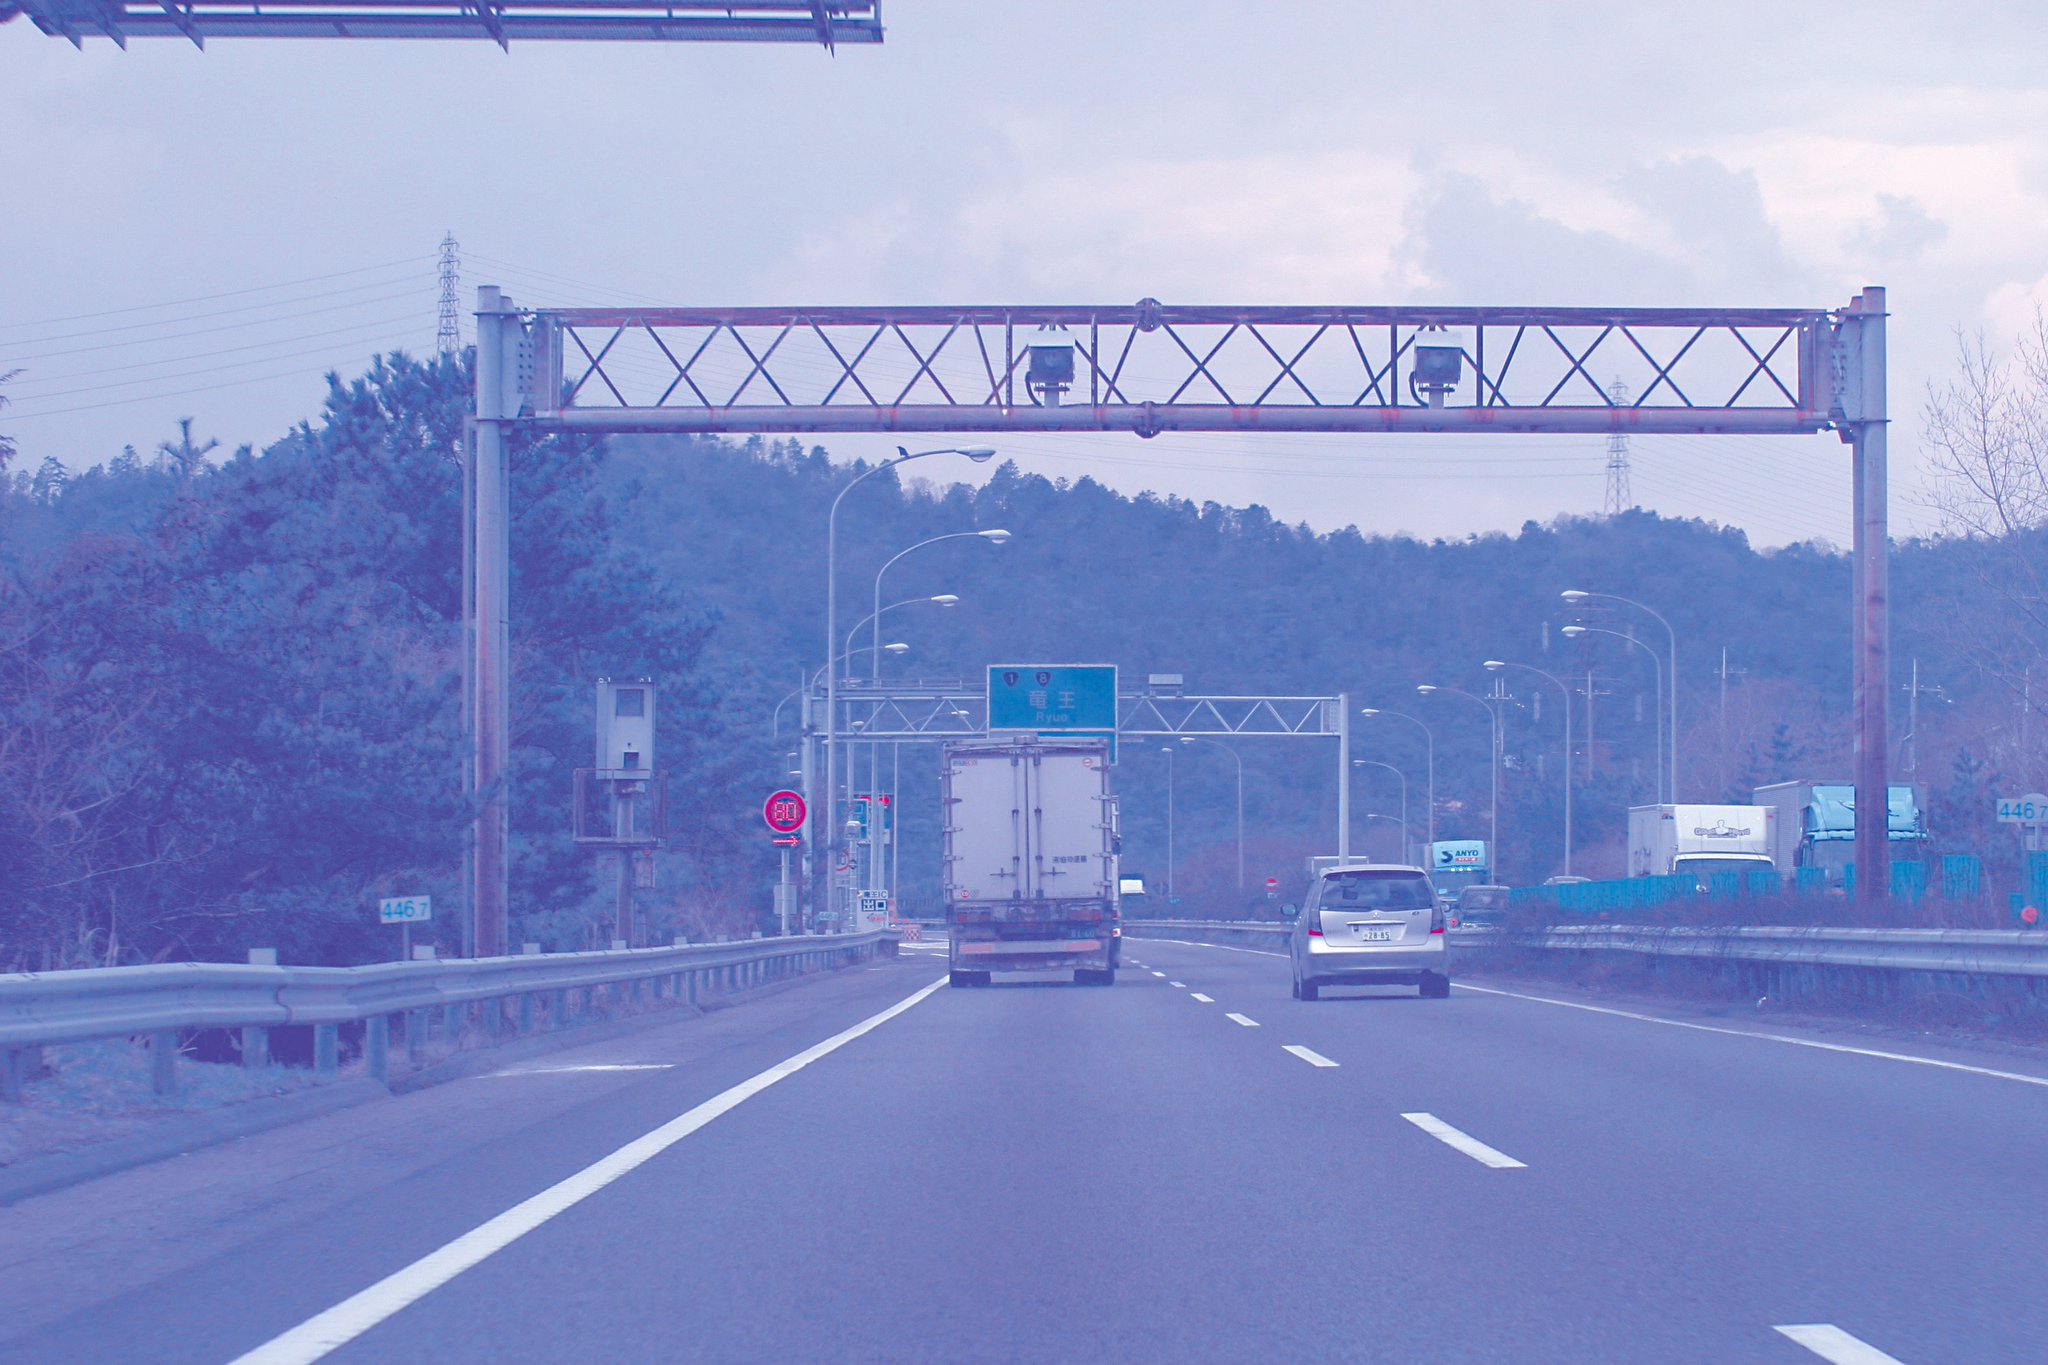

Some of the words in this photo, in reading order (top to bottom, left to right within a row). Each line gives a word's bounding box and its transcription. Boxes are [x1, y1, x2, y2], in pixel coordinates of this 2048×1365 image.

[1009, 673, 1014, 683] 1
[1039, 673, 1047, 683] 8
[1036, 712, 1068, 722] Ryuo
[773, 802, 797, 821] 80
[863, 900, 887, 911] 出口
